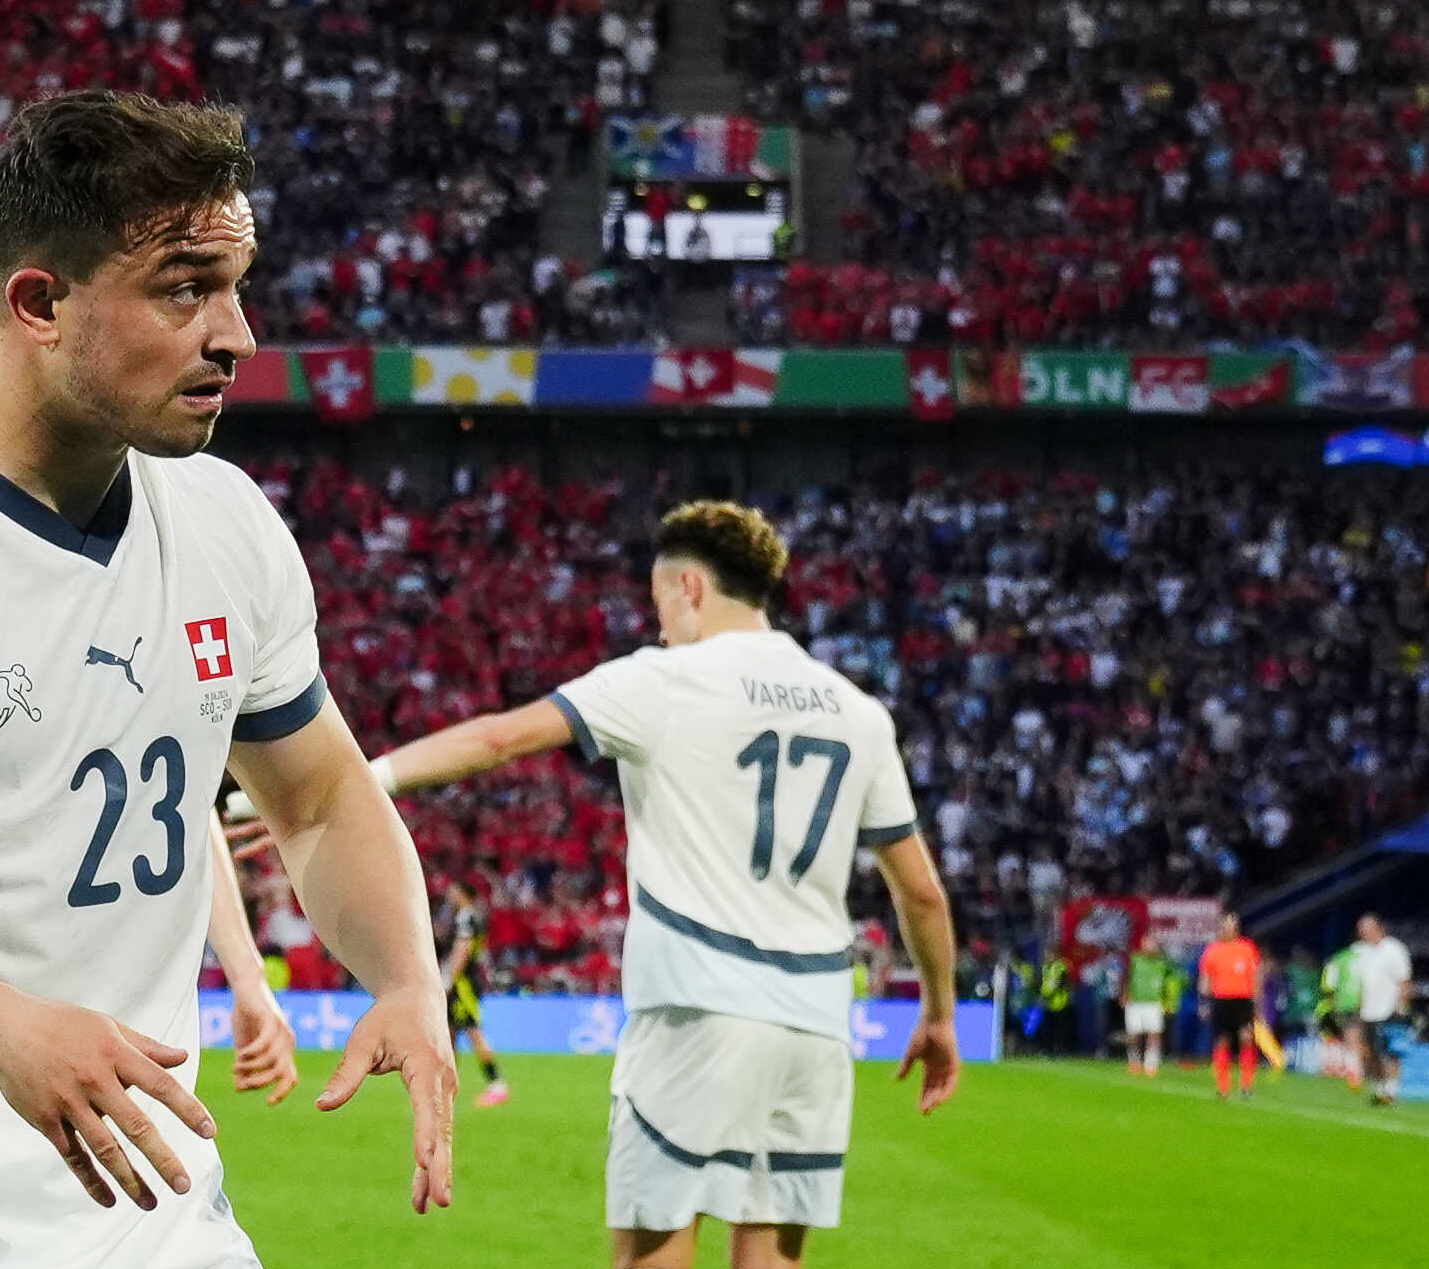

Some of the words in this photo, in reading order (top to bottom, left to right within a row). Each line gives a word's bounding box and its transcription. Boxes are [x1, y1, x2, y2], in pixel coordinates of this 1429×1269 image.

[1021, 355, 1126, 403] ÖLN
[741, 678, 841, 715] VARGAS
[67, 735, 186, 908] 23
[736, 729, 851, 888] 17
